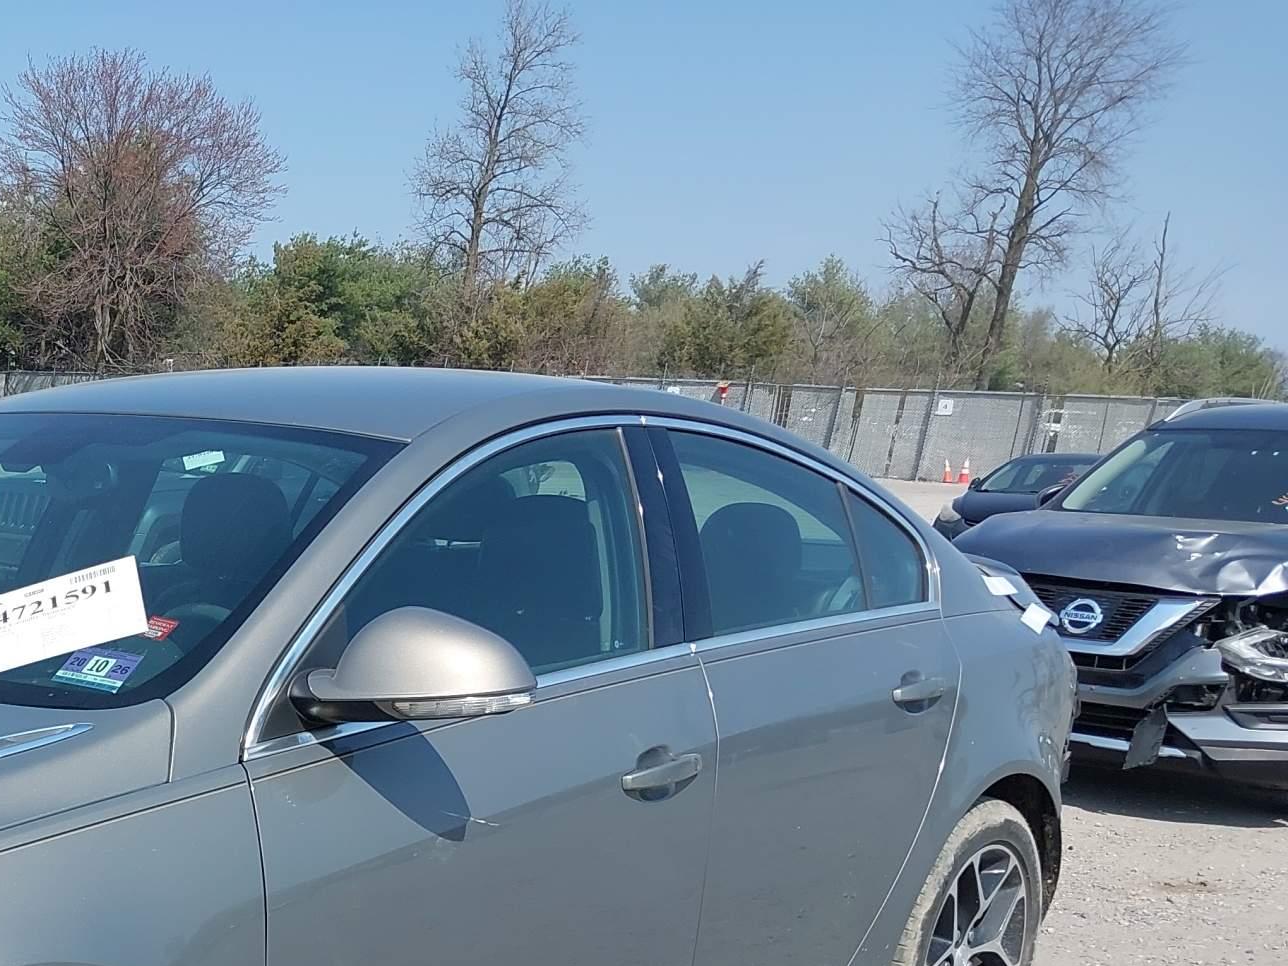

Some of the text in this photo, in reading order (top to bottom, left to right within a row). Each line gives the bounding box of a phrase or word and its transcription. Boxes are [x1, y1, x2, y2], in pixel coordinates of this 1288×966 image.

[1063, 611, 1098, 621] NISSAN
[70, 656, 130, 675] 20 10 26
